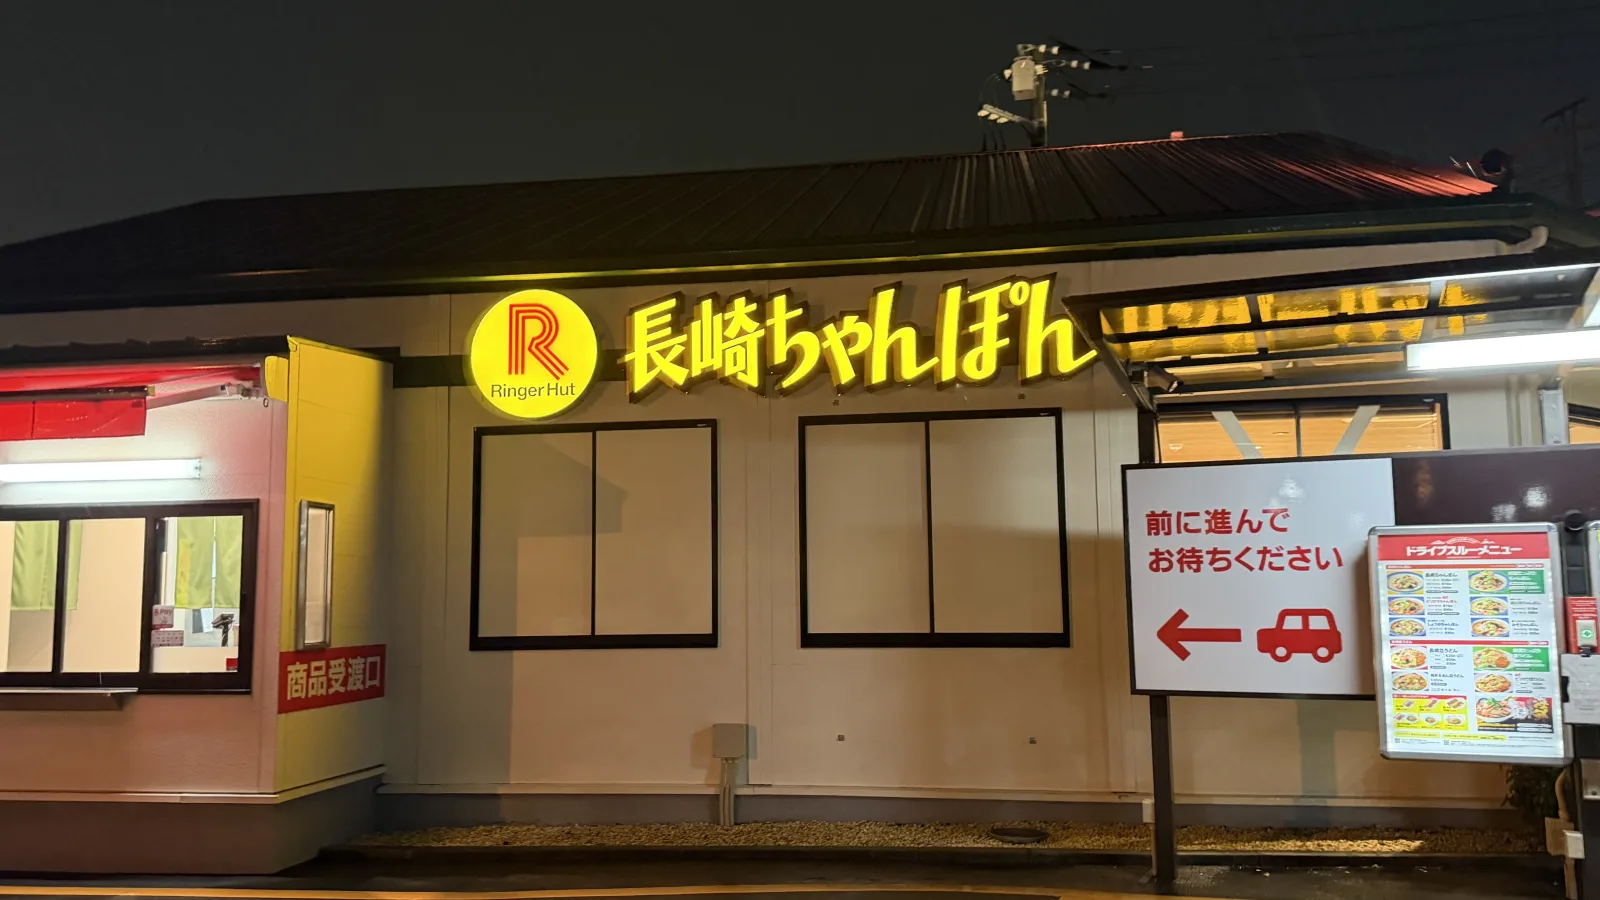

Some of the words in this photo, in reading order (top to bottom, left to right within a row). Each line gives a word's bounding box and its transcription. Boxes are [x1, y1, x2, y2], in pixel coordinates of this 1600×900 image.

[508, 303, 569, 381] R
[624, 279, 1099, 393] 長崎ちゃんぽん
[491, 383, 545, 401] Ringer
[547, 382, 576, 396] Hut
[1145, 507, 1290, 537] 前に進んで
[1148, 545, 1344, 573] お待ちください
[1406, 545, 1522, 556] ドライブスルーメニュー
[286, 655, 381, 700] 商品受渡口
